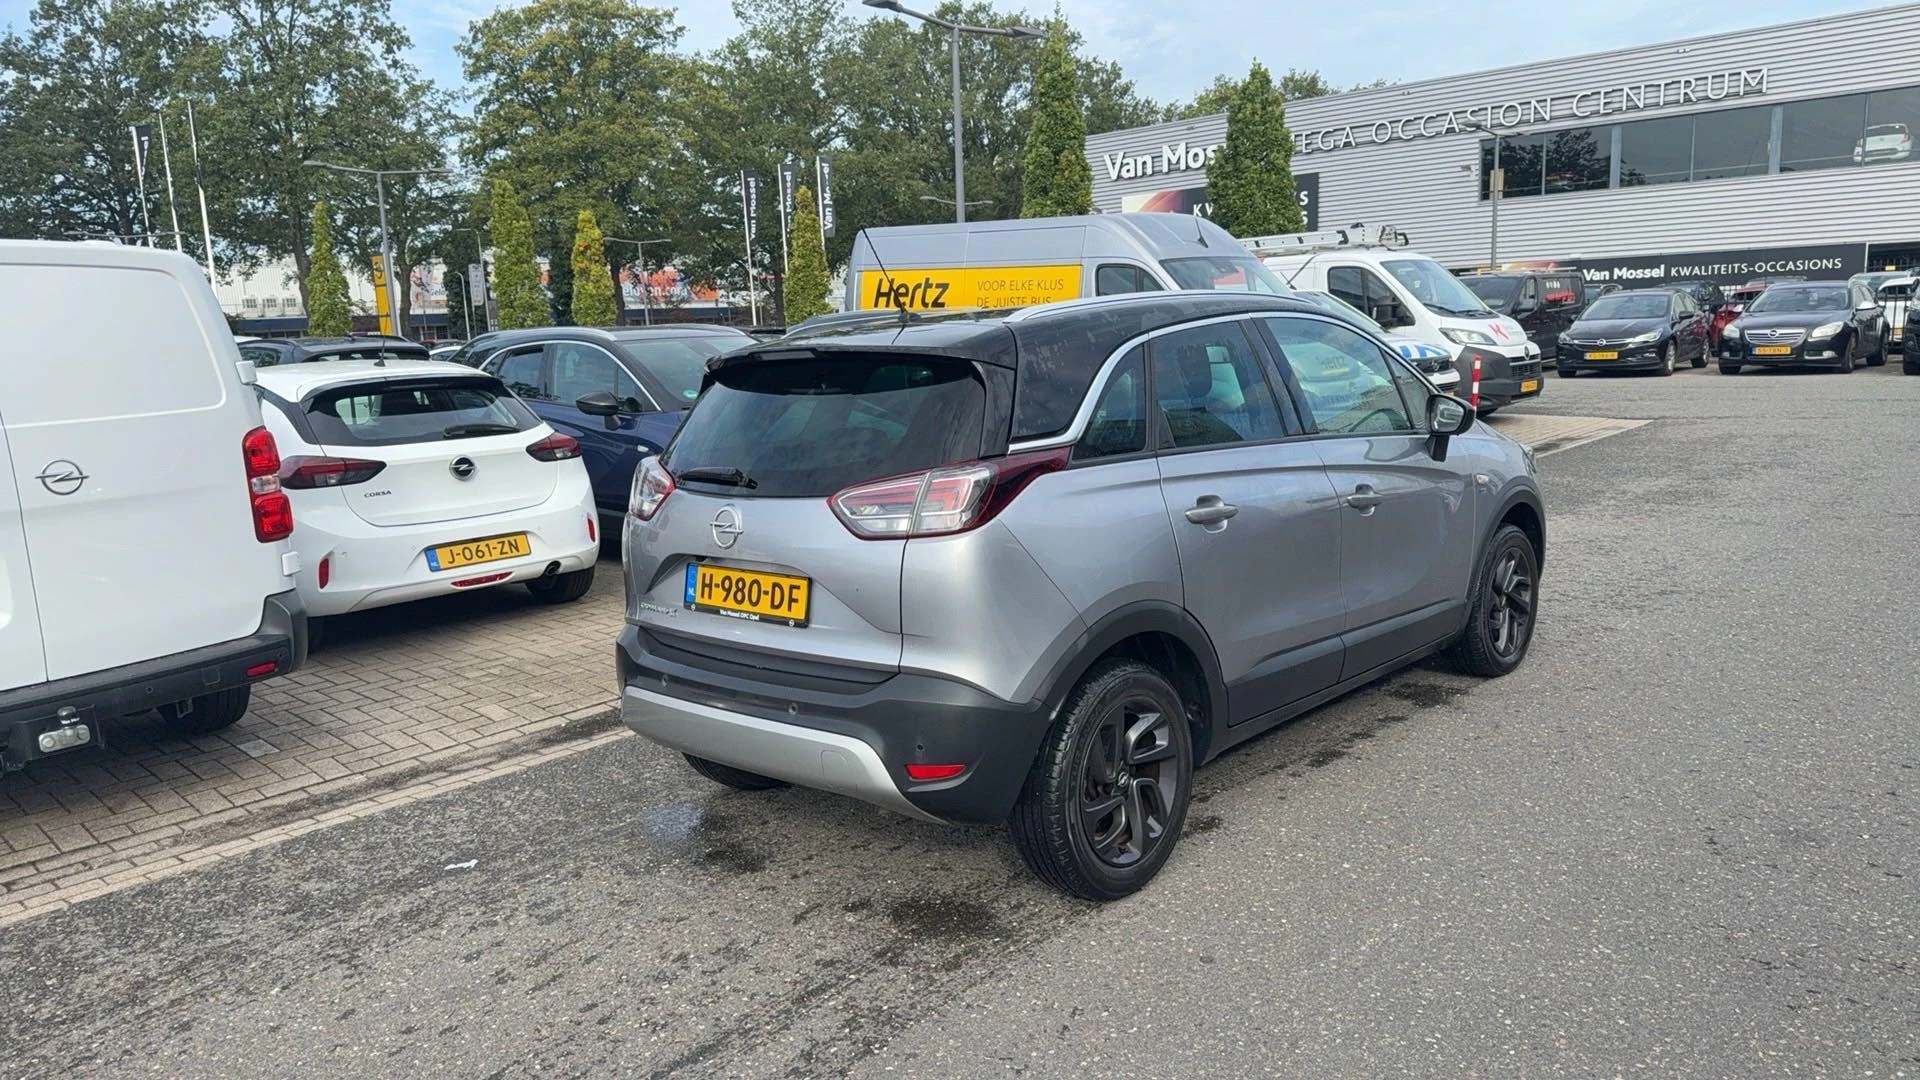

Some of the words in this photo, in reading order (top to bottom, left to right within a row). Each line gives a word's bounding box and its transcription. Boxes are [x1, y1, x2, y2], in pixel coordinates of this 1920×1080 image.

[1290, 126, 1356, 153] EGA
[1371, 97, 1552, 143] OCCASION
[1572, 67, 1769, 117] CENTRUM
[1103, 151, 1153, 181] Van
[1161, 142, 1217, 173] Mos
[747, 177, 757, 217] Mossel
[823, 208, 833, 230] Van
[1582, 268, 1610, 281] Van
[1613, 264, 1665, 280] Mossel
[1670, 258, 1842, 277] KWALITEITS-OCCASIONS
[873, 277, 950, 309] Hertz
[977, 279, 1006, 292] VOOR
[1009, 279, 1034, 291] ELKE
[1037, 278, 1064, 291] KLUS
[976, 297, 990, 308] DE
[993, 296, 1027, 308] JUISTE
[447, 538, 520, 564] J-061-ZN
[700, 573, 801, 612] H-980-DF
